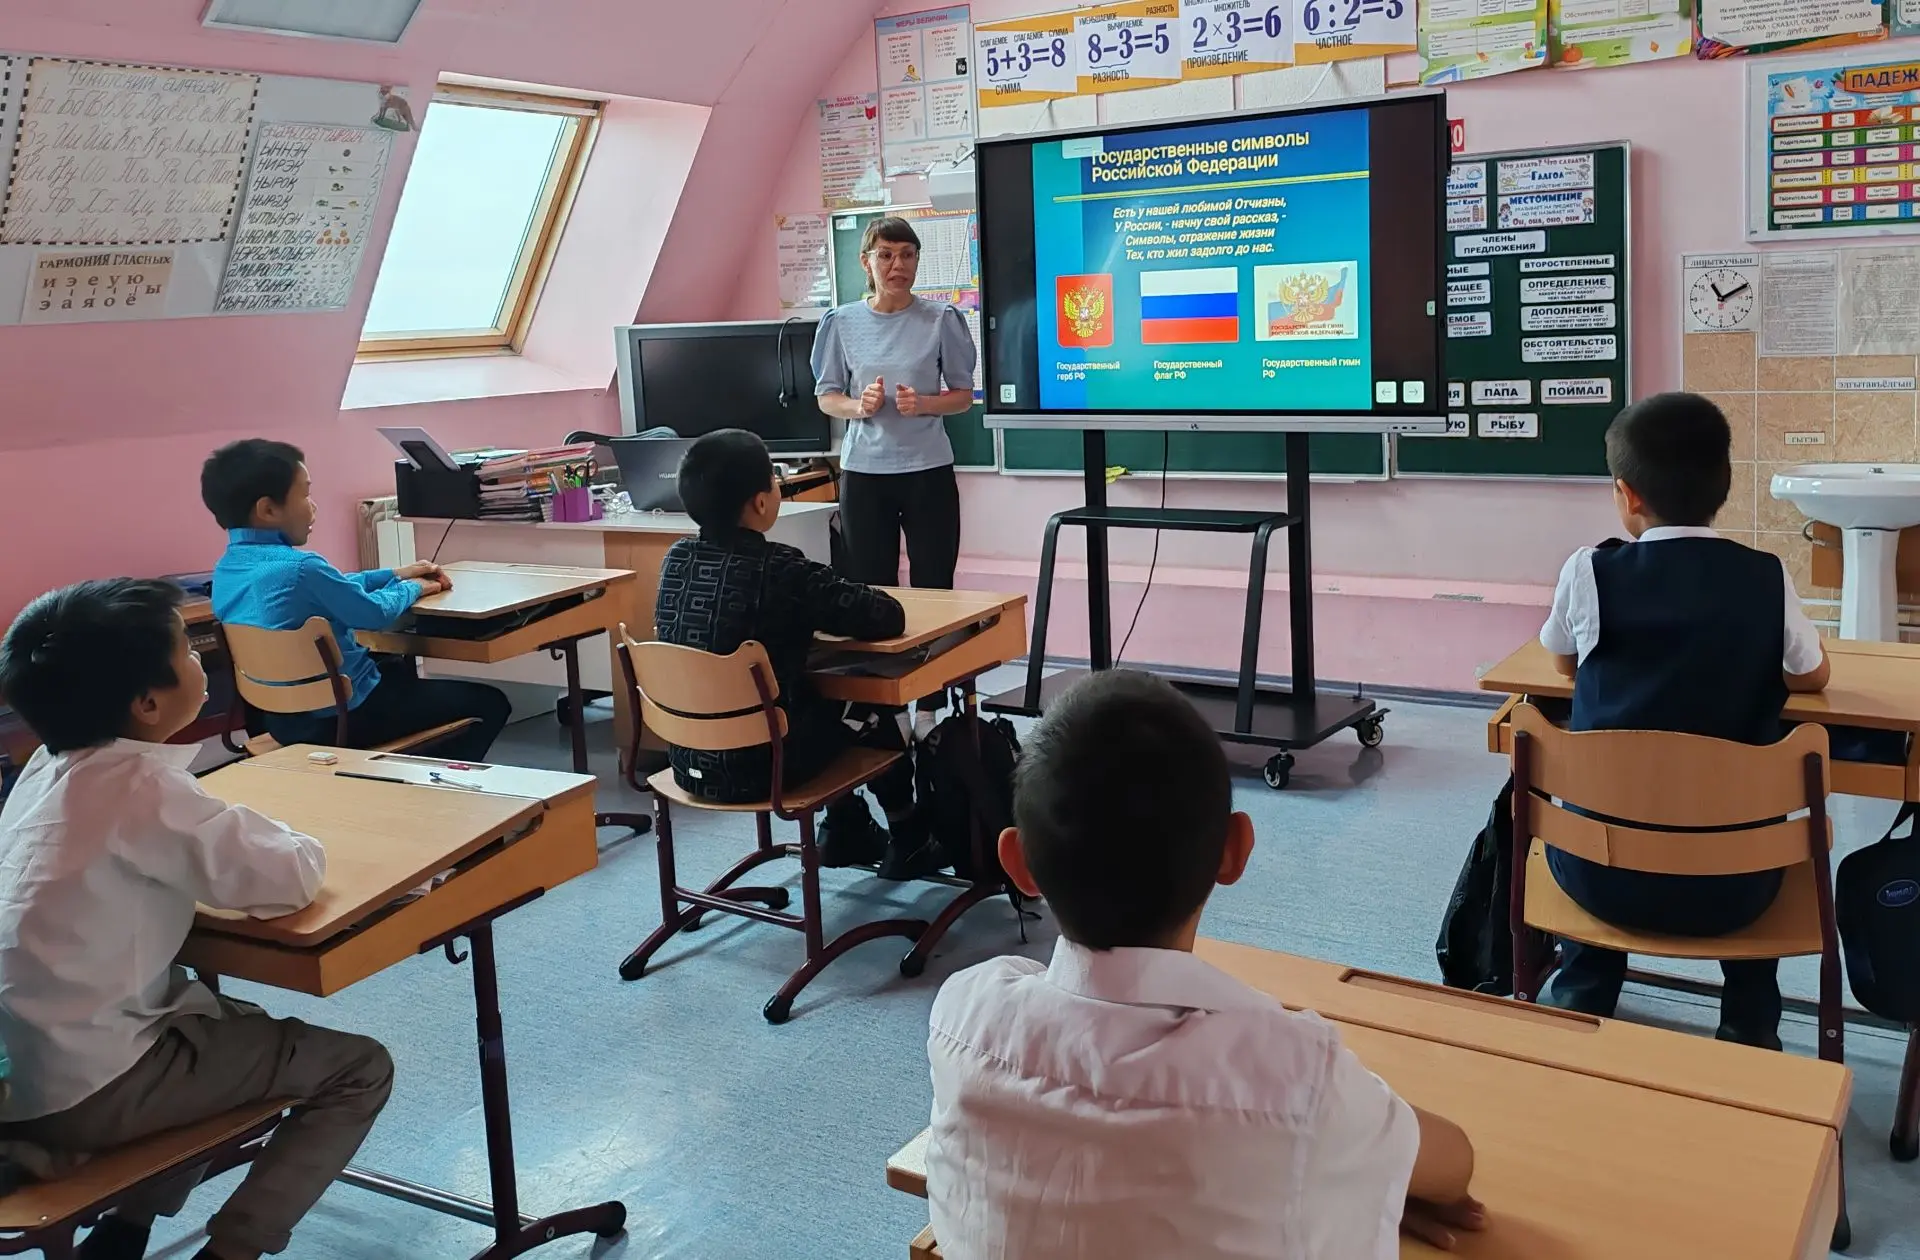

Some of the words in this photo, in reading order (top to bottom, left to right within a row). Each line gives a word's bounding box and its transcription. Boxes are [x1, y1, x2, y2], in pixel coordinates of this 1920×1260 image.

[1079, 12, 1118, 26] УМЕНЬШАЕМОЕ
[1145, 4, 1175, 15] РАЗНОСТЬ
[1107, 18, 1143, 31] ВЫЧИТАЕМОЕ
[980, 36, 1008, 48] СЛАГАЕМОЕ
[1013, 31, 1044, 43] СЛАГАЕМОЕ
[1048, 28, 1069, 38] СУММА
[1316, 33, 1353, 50] ЧАСТНОЕ
[987, 38, 1066, 76] 5+3=8
[1186, 50, 1249, 69] ПРОИЗВЕДЕНИЕ
[1092, 69, 1130, 84] РАЗНОСТЬ
[995, 84, 1022, 96] СУММА
[1092, 138, 1227, 166] Государственные
[1231, 131, 1310, 151] символы
[1092, 157, 1183, 183] Российской
[1187, 154, 1279, 175] Федерации
[1509, 192, 1583, 205] МЕСТОИМЕНИЕ
[1113, 207, 1136, 219] Есть
[1137, 209, 1146, 219] у
[1147, 203, 1180, 217] нашей
[1181, 199, 1232, 215] любимой
[1235, 197, 1287, 211] Отчизны,
[1124, 218, 1163, 232] России,
[1171, 216, 1203, 230] начну
[1204, 213, 1230, 227] свой
[1232, 212, 1280, 228] рассказ,
[1126, 233, 1177, 247] Символы,
[1179, 230, 1237, 244] отражение
[1238, 227, 1275, 239] жизни
[1482, 235, 1516, 243] ЧЛЕНЫ
[1126, 249, 1145, 261] Тех,
[1147, 248, 1165, 258] кто
[1166, 247, 1189, 258] жил
[1190, 244, 1233, 258] задолго
[1234, 244, 1250, 256] до
[1252, 242, 1275, 254] нас.
[1464, 243, 1536, 254] ПРЕДЛОЖЕНИЯ
[39, 253, 111, 269] ГАРМОНИЯ
[1524, 258, 1610, 268] ВТОРОСТЕПЕННЫЕ
[66, 276, 77, 288] э
[87, 275, 99, 286] е
[107, 274, 121, 289] у
[127, 274, 144, 285] ю
[1528, 278, 1606, 288] ОПРЕДЕЛЕНИЕ
[145, 284, 162, 294] ы
[39, 300, 51, 311] э
[61, 298, 72, 309] а
[82, 297, 95, 309] я
[103, 297, 116, 308] о
[125, 293, 137, 306] ё
[1531, 306, 1604, 316] ДОПОЛНЕНИЕ
[1524, 338, 1614, 348] ОБСТОЯТЕЛЬСТВО
[1056, 360, 1120, 371] Государственный
[1153, 359, 1223, 370] Государственный
[1262, 357, 1337, 369] Государственный
[1339, 358, 1361, 367] гимн
[1057, 372, 1073, 381] герб
[1074, 371, 1085, 381] РФ
[1154, 370, 1173, 381] флаг
[1174, 370, 1186, 380] РФ
[1262, 369, 1276, 379] РФ
[1485, 388, 1518, 397] ПАПА
[1548, 386, 1604, 396] ПОЙМАЛ
[1491, 421, 1525, 430] РЫБУ
